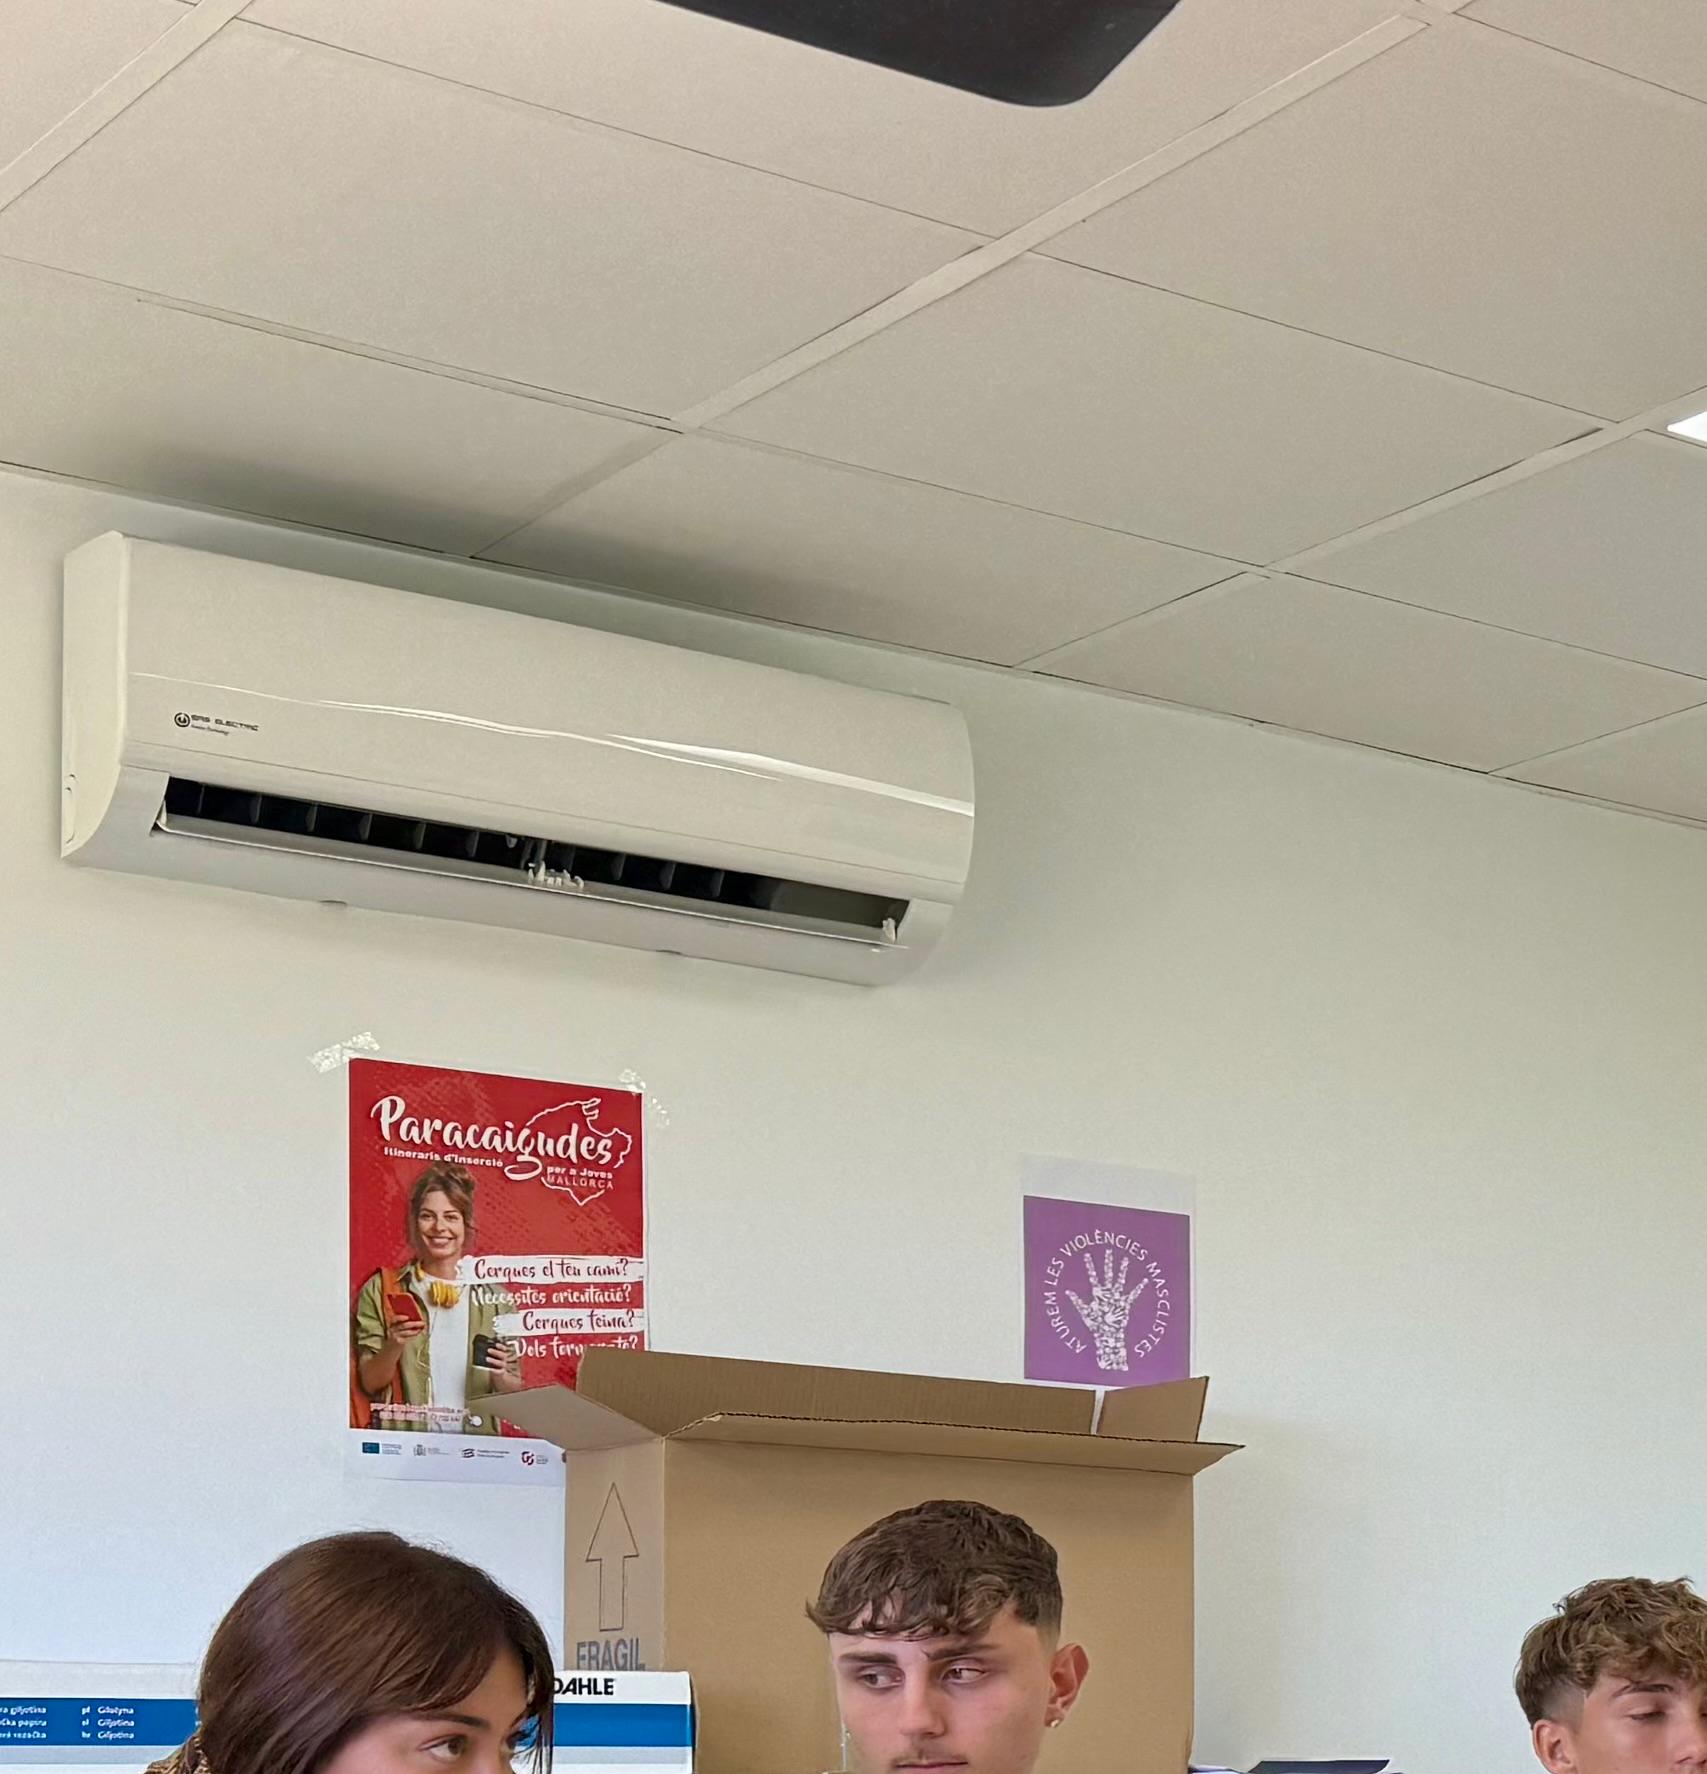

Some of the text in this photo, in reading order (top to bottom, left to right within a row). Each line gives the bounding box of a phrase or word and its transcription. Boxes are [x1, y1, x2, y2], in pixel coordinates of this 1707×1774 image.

[370, 1095, 613, 1180] Paracaigudes
[547, 1175, 614, 1190] MALLORCA
[474, 1259, 536, 1282] Cerques
[542, 1260, 554, 1278] el
[556, 1261, 581, 1277] teu
[1045, 1257, 1064, 1286] LES
[471, 1286, 547, 1306] Necessites
[1134, 1262, 1170, 1358] MASCLISTES
[522, 1310, 635, 1336] Cerques feina?
[1044, 1292, 1087, 1353] ATUREM
[513, 1338, 547, 1357] Vols
[553, 1678, 615, 1695] DAHLE
